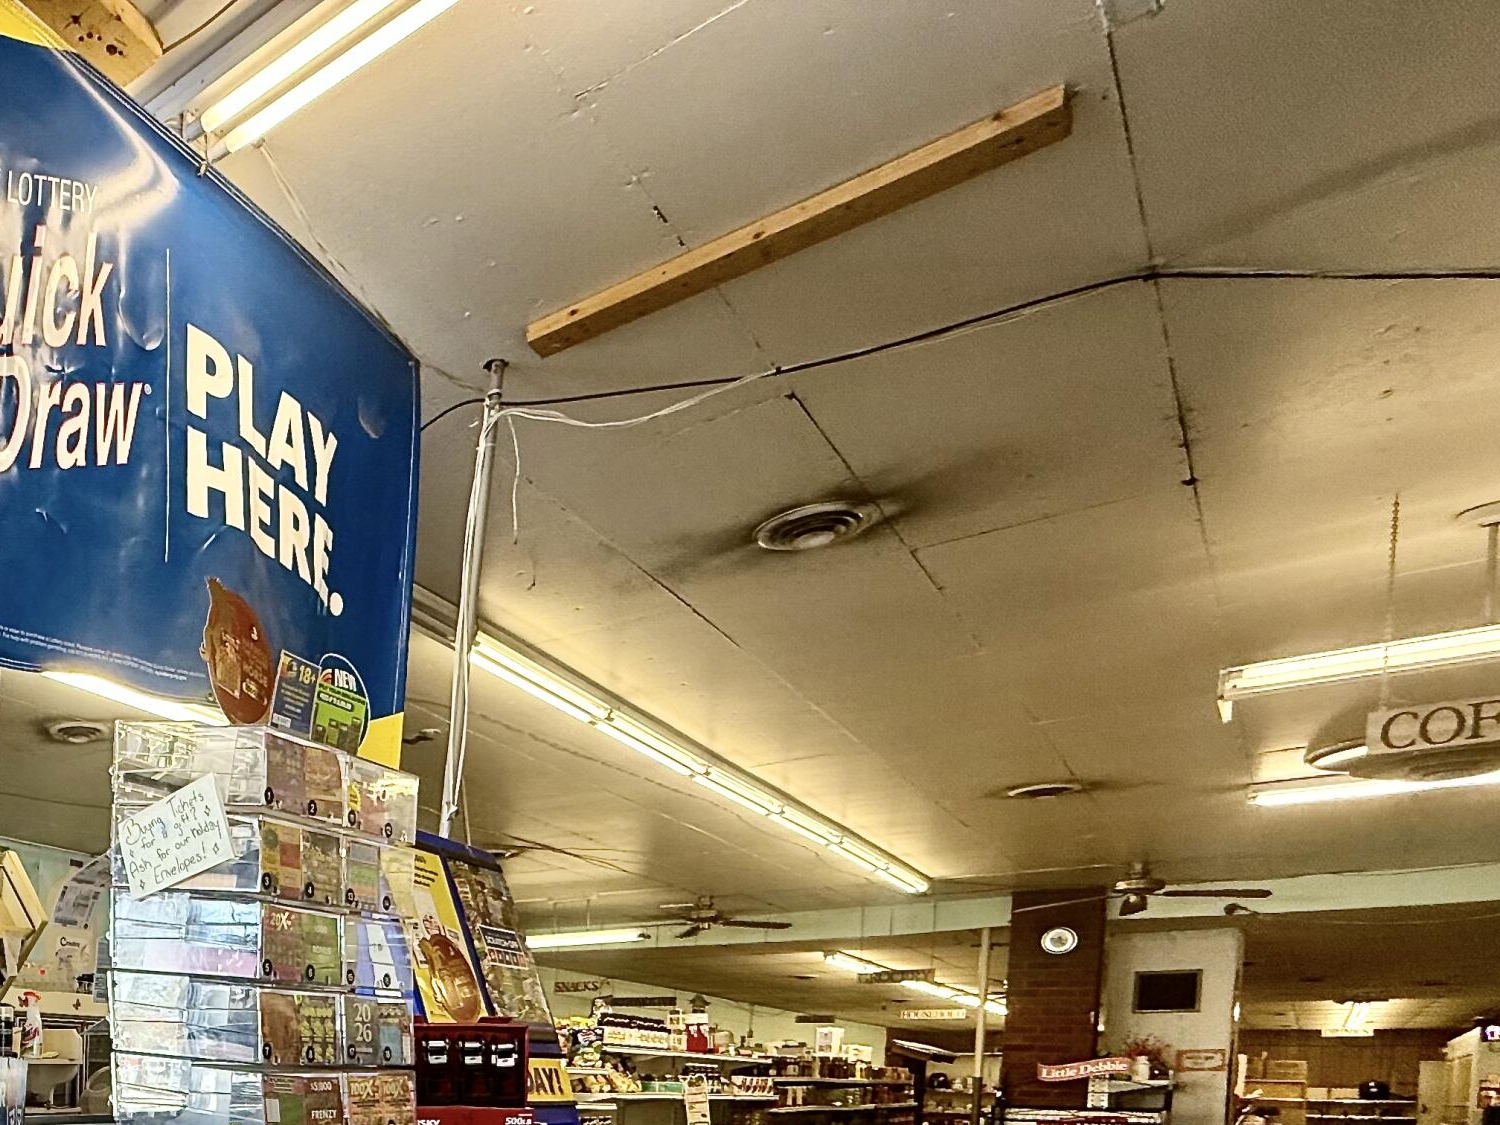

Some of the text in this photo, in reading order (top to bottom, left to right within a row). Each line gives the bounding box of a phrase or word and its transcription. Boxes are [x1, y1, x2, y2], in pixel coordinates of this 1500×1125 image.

[7, 171, 98, 214] LOTTERY
[187, 323, 338, 507] PLAY
[187, 425, 343, 616] HERE.
[129, 844, 152, 878] Ask
[156, 848, 171, 861] for
[174, 836, 191, 850] our
[141, 838, 156, 849] for
[554, 981, 599, 993] SNACKS
[1042, 1060, 1128, 1079] Little Debbie
